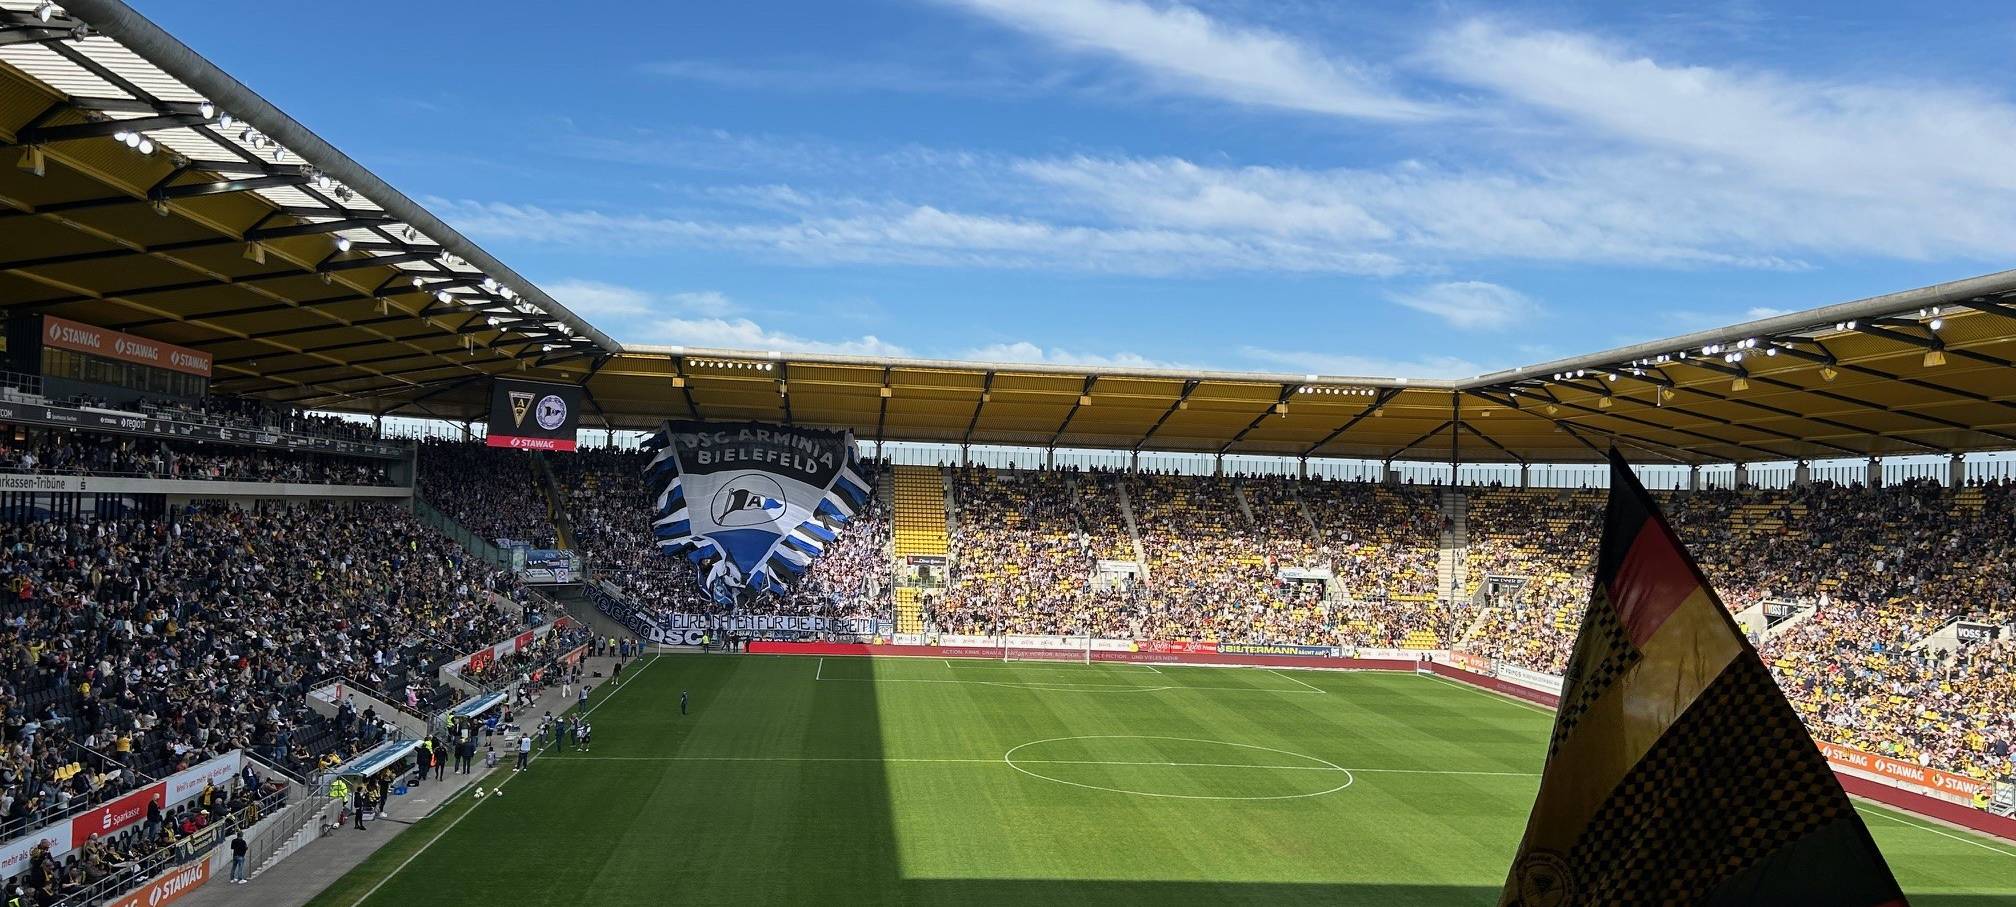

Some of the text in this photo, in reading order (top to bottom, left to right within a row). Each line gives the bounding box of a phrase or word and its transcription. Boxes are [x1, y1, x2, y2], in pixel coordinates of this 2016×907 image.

[62, 327, 100, 348] STAWAG
[126, 342, 158, 361] STAWAG
[180, 353, 209, 371] STAWAG
[521, 439, 554, 448] STAWAG
[738, 428, 834, 470] ARMINIA
[697, 448, 818, 474] BIELEFELD
[746, 496, 762, 508] A
[788, 616, 810, 630] DIE
[648, 627, 705, 646] DSC
[1958, 628, 1981, 638] VOSS
[1886, 762, 1925, 782] STAWAG
[113, 808, 140, 825] Sparkasse
[1, 854, 18, 868] mehr
[19, 850, 28, 861] als
[162, 863, 204, 900] STAWAG
